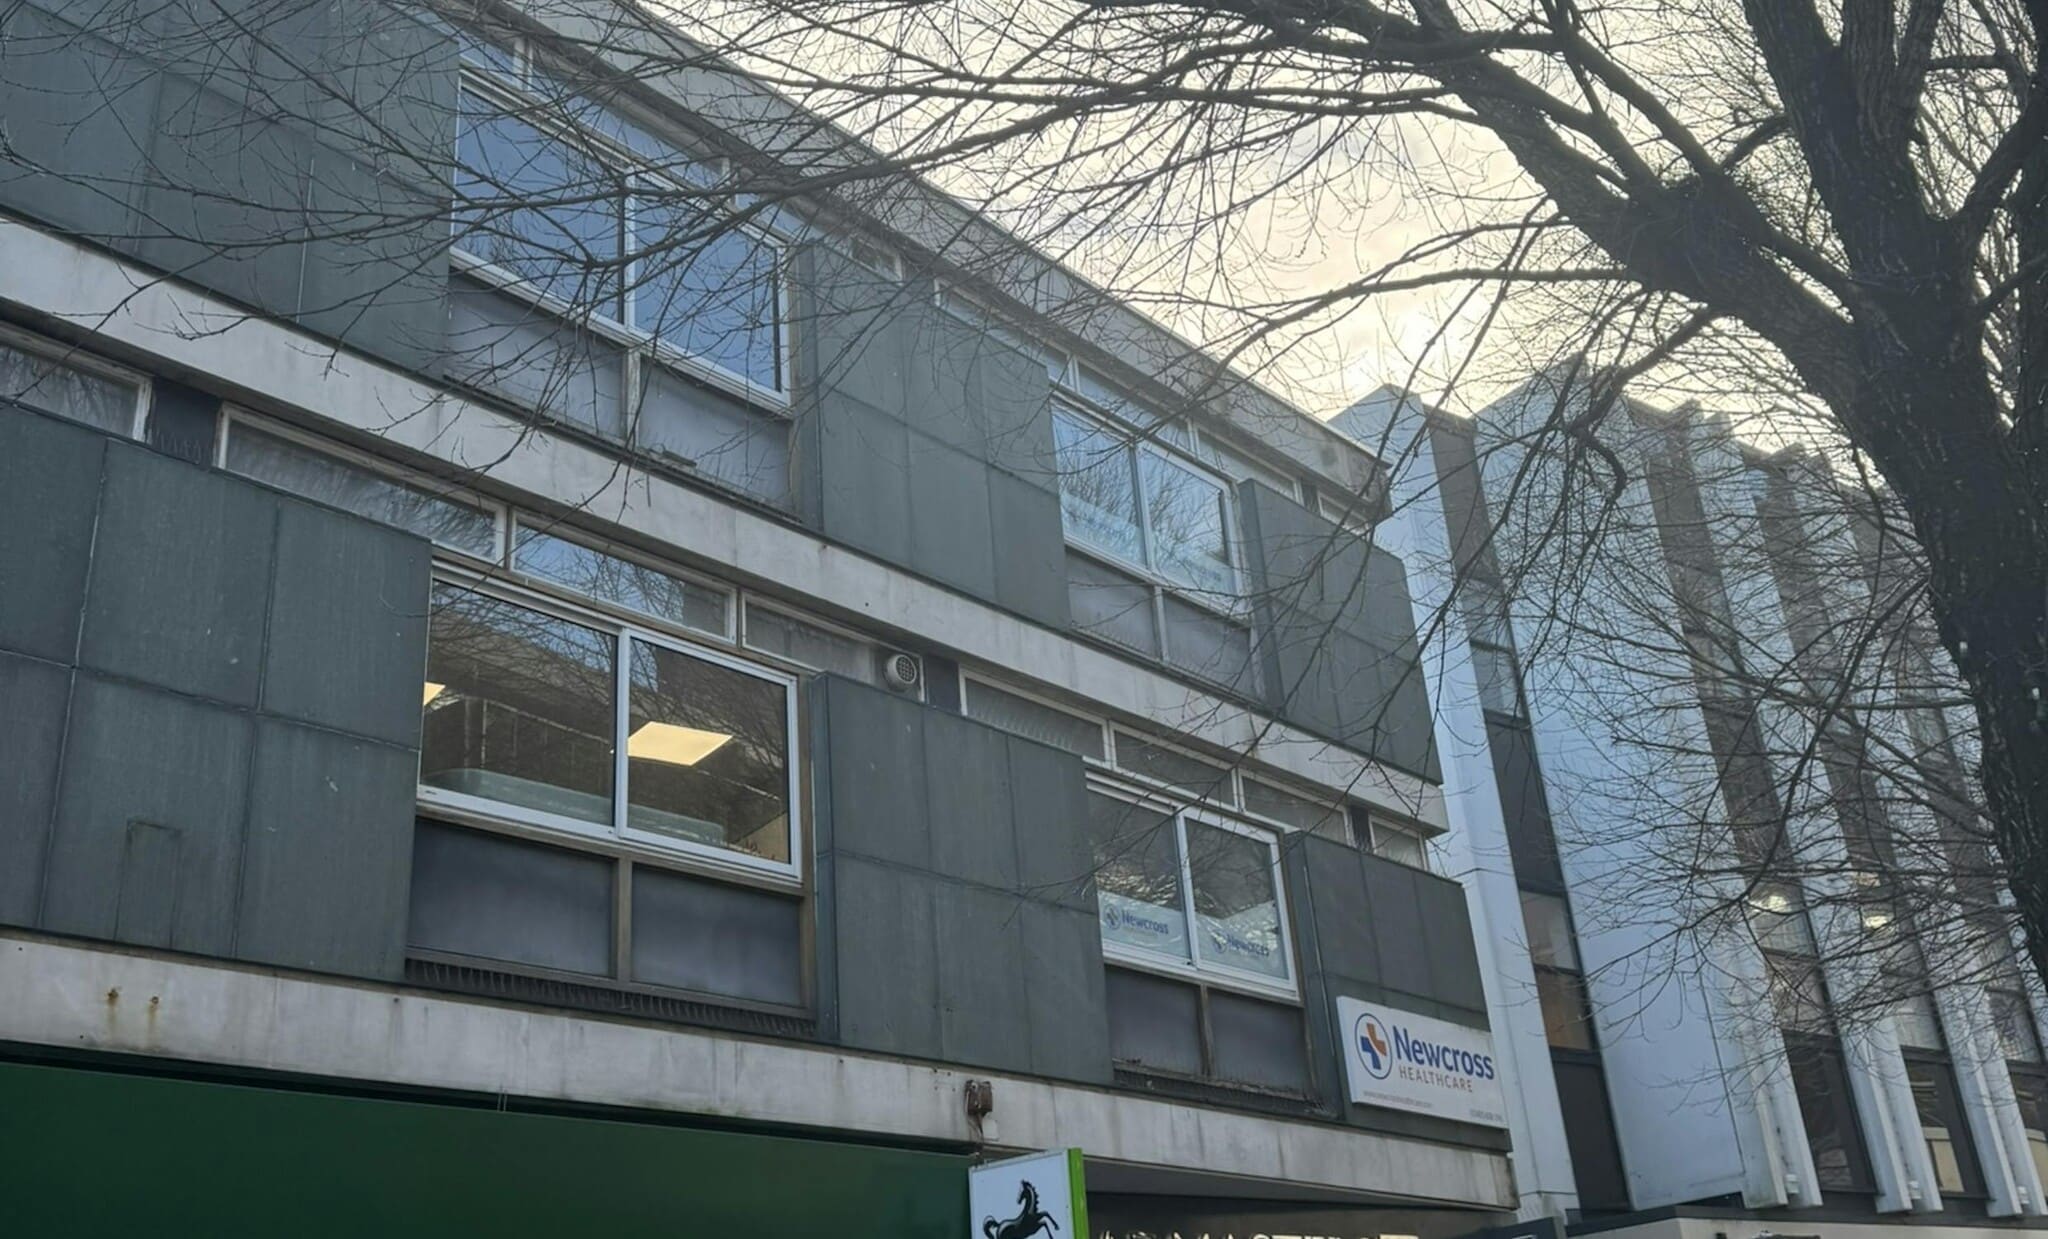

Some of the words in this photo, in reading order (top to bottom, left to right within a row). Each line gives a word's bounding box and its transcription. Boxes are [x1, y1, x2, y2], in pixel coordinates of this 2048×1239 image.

[1121, 909, 1169, 935] Newcross
[1392, 1025, 1495, 1081] Newcross
[1399, 1066, 1474, 1094] HEALTHCARE
